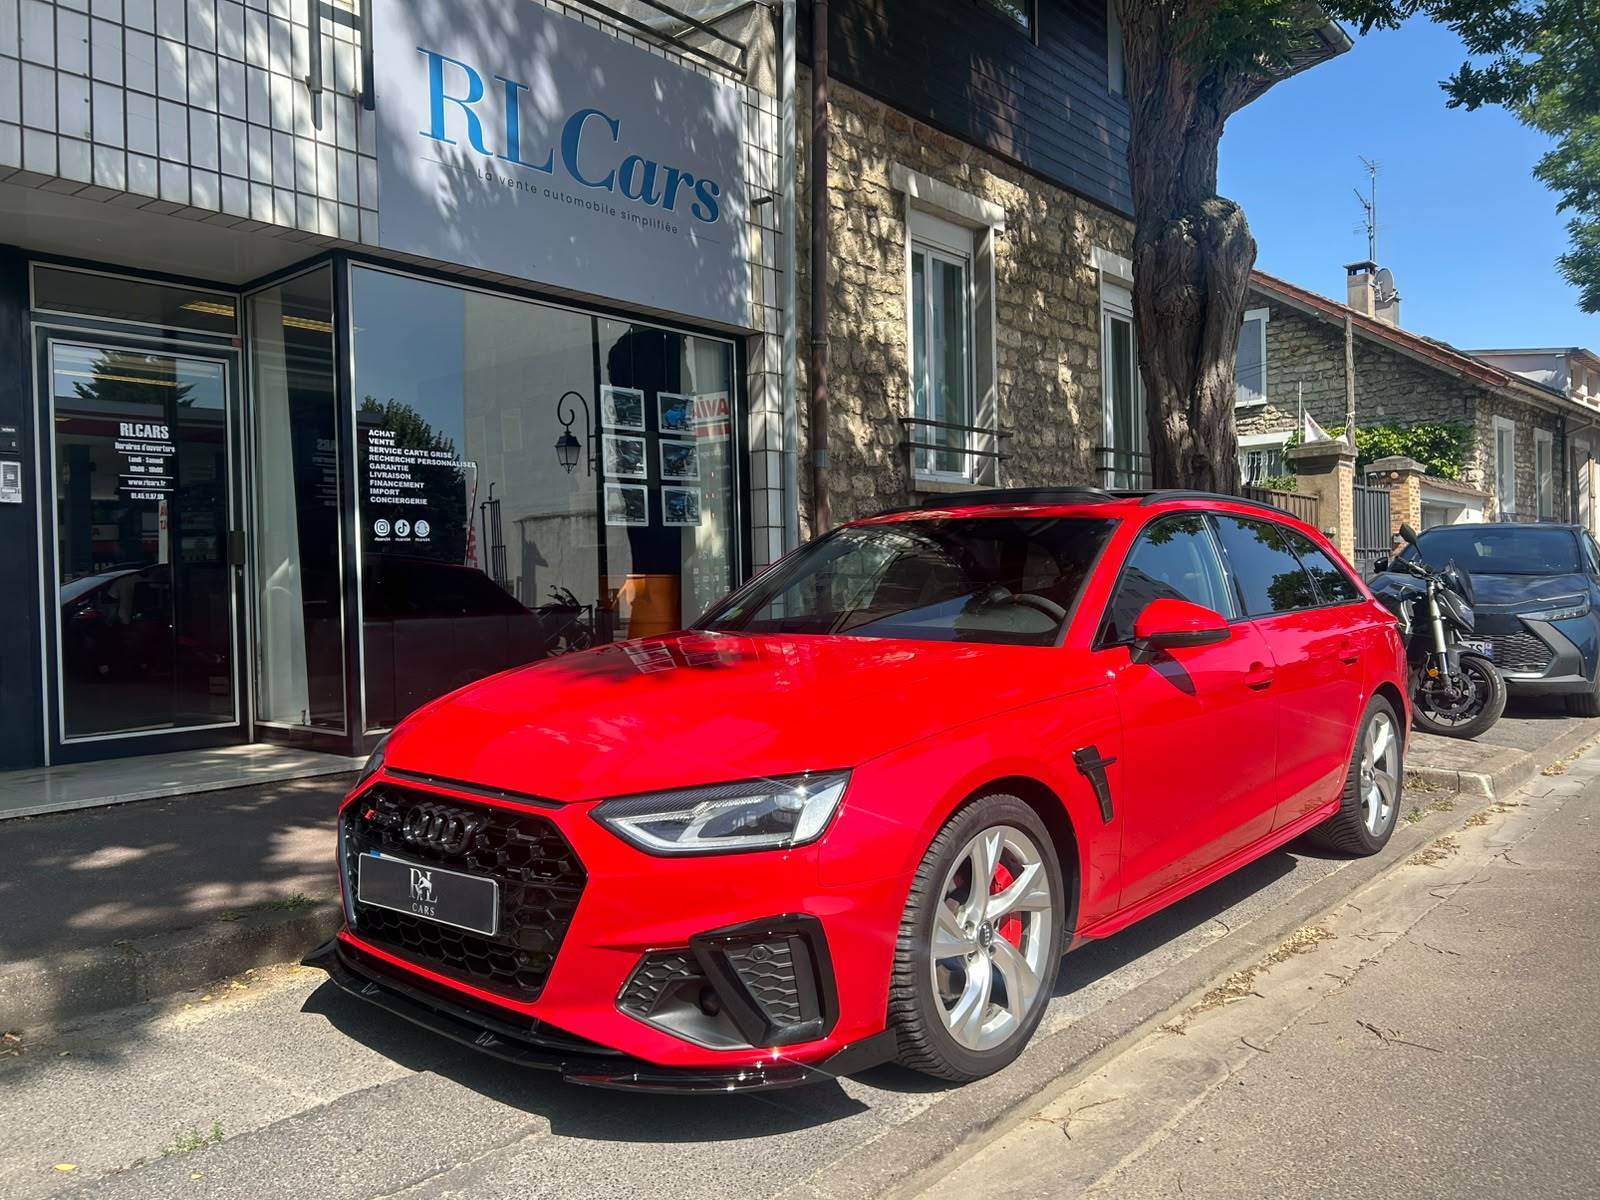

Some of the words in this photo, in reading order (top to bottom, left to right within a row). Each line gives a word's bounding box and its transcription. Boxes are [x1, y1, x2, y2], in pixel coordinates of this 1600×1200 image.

[477, 168, 493, 182] La
[498, 175, 538, 194] vente
[543, 188, 616, 217] automobile
[620, 209, 679, 235] simplifiée
[119, 422, 169, 439] RLCARS
[368, 429, 396, 438] ACHAT
[368, 437, 395, 446] VENTE
[368, 446, 402, 455] SERVICE
[403, 449, 430, 457] CARTE
[430, 450, 453, 459] GRISE
[368, 454, 416, 464] RECHERCHE
[369, 463, 409, 472] GARANTIE
[369, 471, 411, 480] LIVRAISON
[369, 480, 425, 489] FINANCEMENT
[370, 488, 400, 496] IMPORT
[370, 496, 428, 505] CONCIERGERIE
[412, 902, 435, 916] CARS
